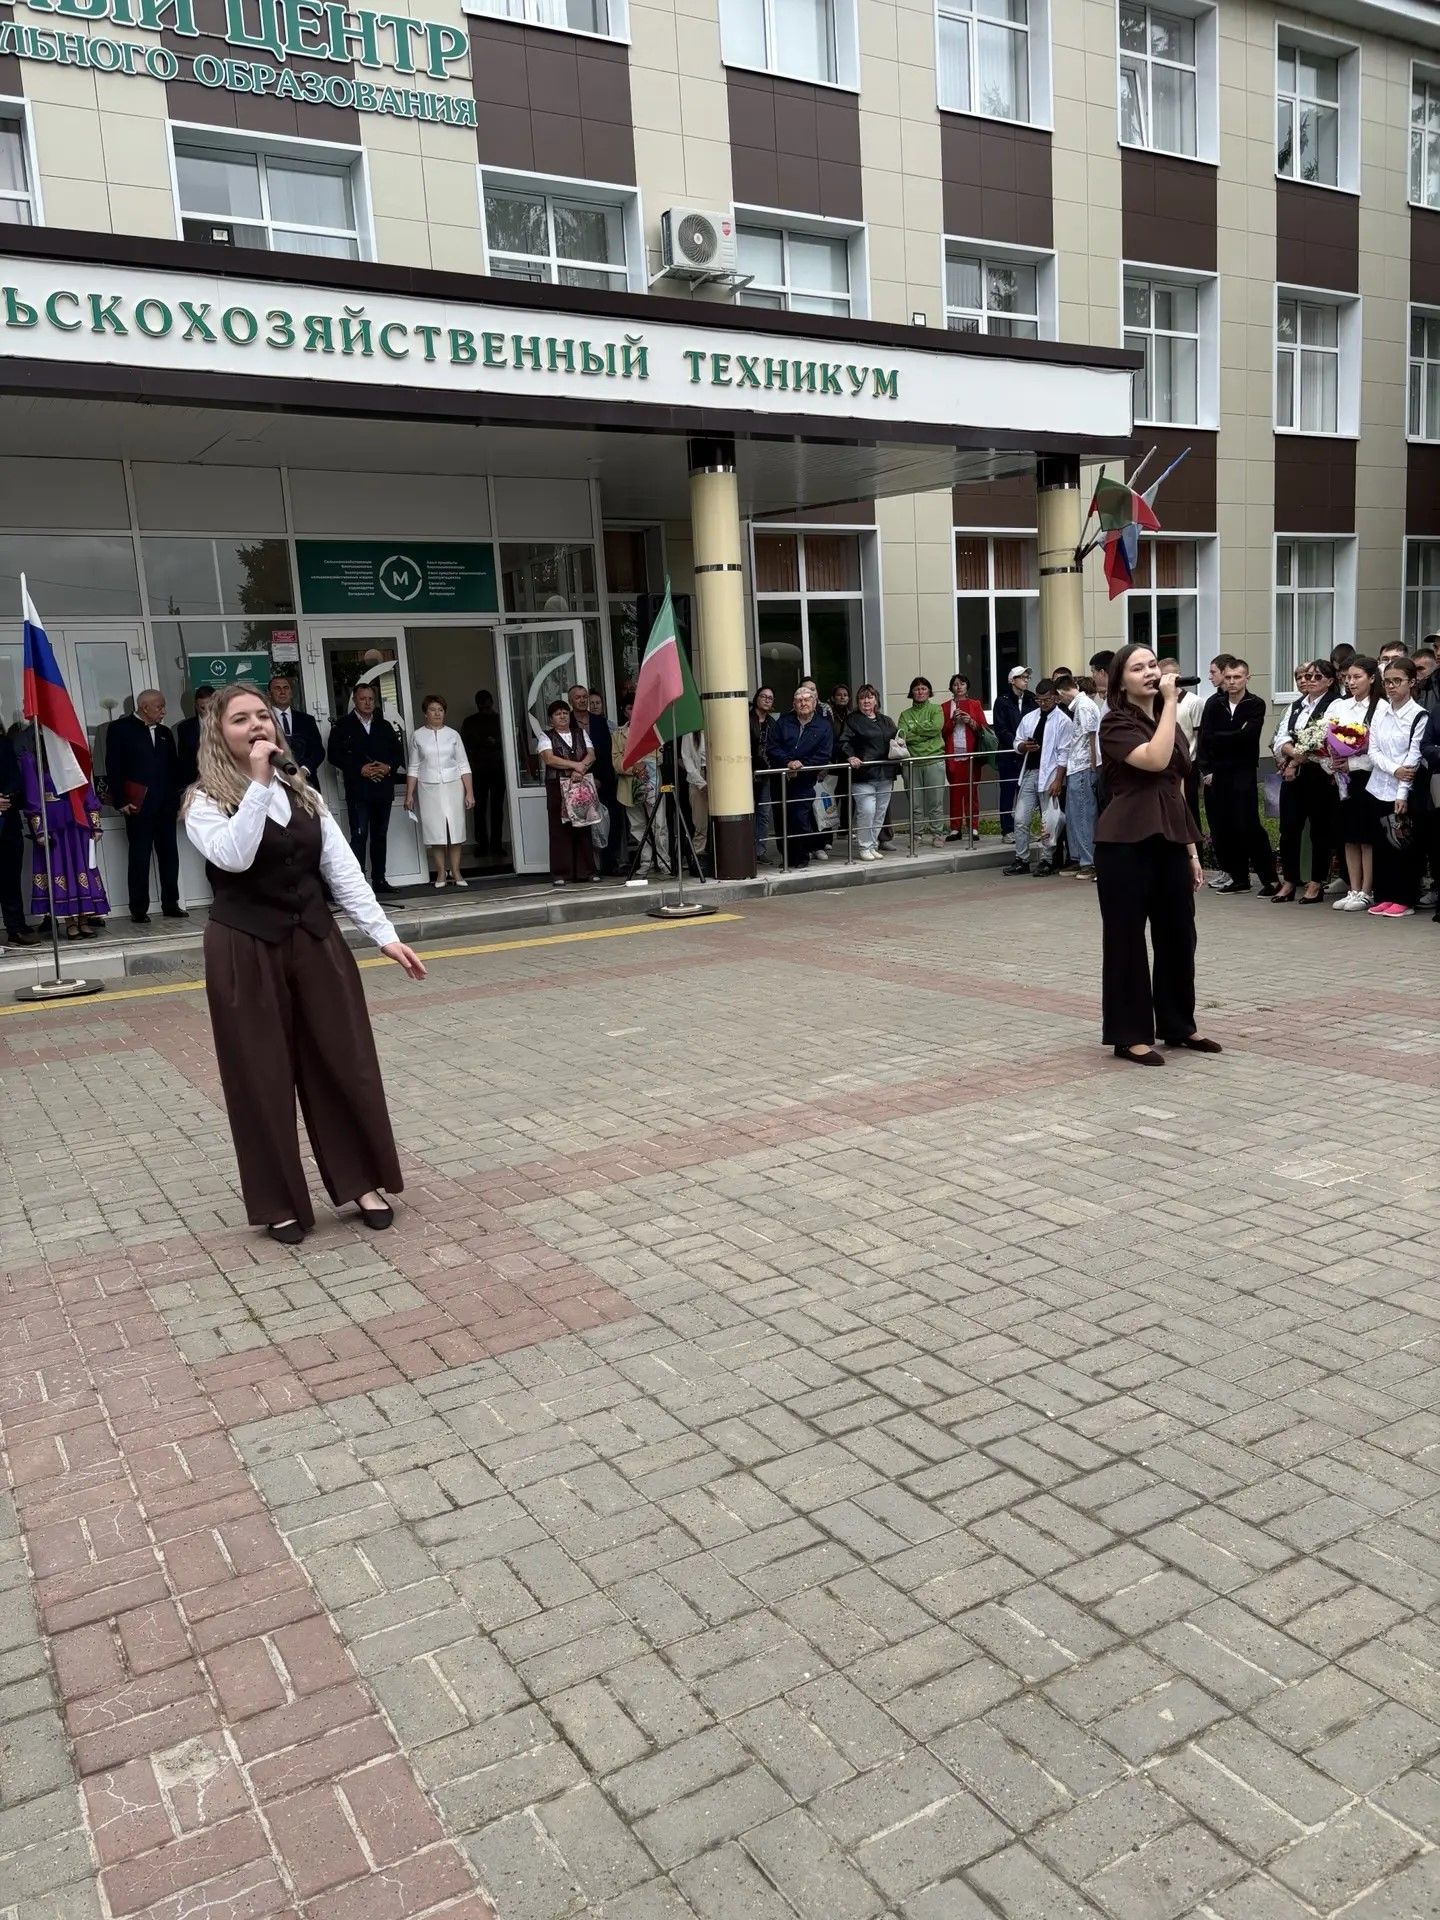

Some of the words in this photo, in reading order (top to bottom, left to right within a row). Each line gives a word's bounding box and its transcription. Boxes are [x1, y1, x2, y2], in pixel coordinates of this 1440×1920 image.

[225, 0, 469, 79] ЦЕНТР
[193, 53, 479, 127] ОБРАЗОВАНИЯ
[2, 286, 650, 379] ЬСКОХОЗЯЙСТВЕННЫЙ
[683, 349, 900, 399] ТЕХНИКУМ
